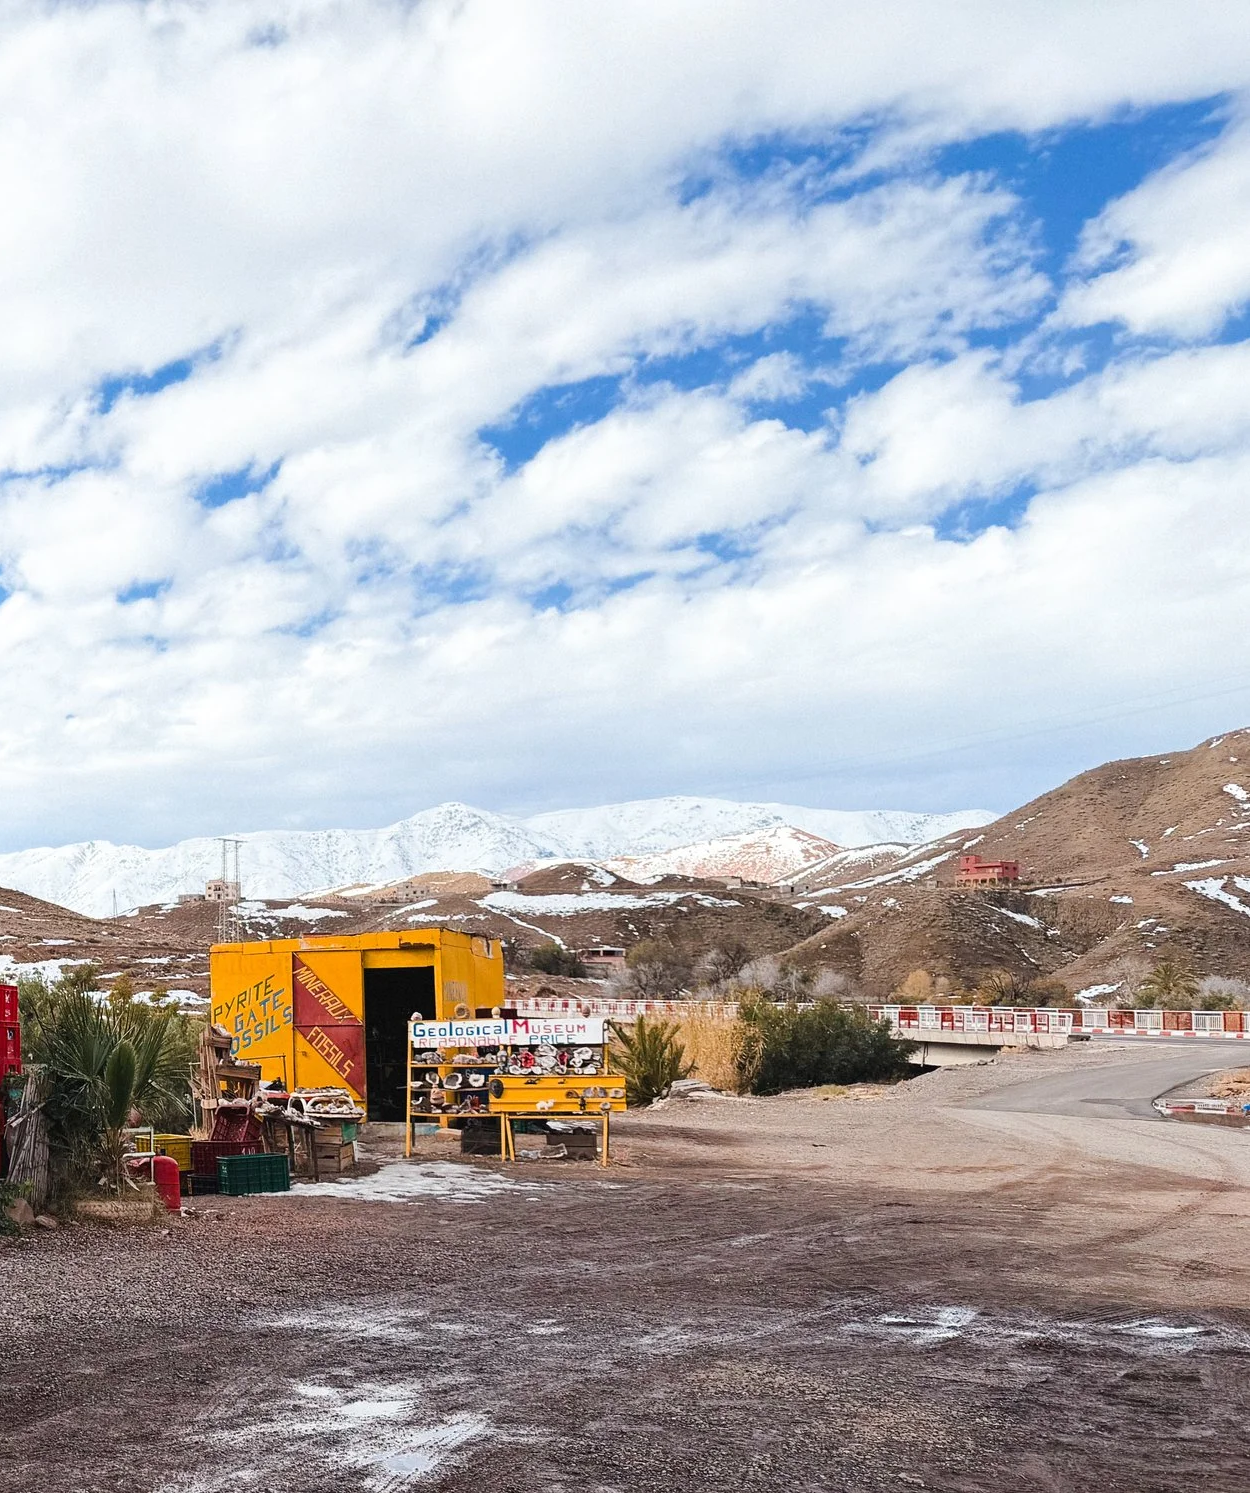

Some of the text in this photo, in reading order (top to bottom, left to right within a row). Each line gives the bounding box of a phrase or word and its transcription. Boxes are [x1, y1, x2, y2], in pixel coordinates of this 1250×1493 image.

[213, 974, 275, 1025] PYRITE
[293, 966, 356, 1025] MINERAUX
[230, 1005, 293, 1055] OSSILS
[306, 1026, 355, 1080] FOSSILS
